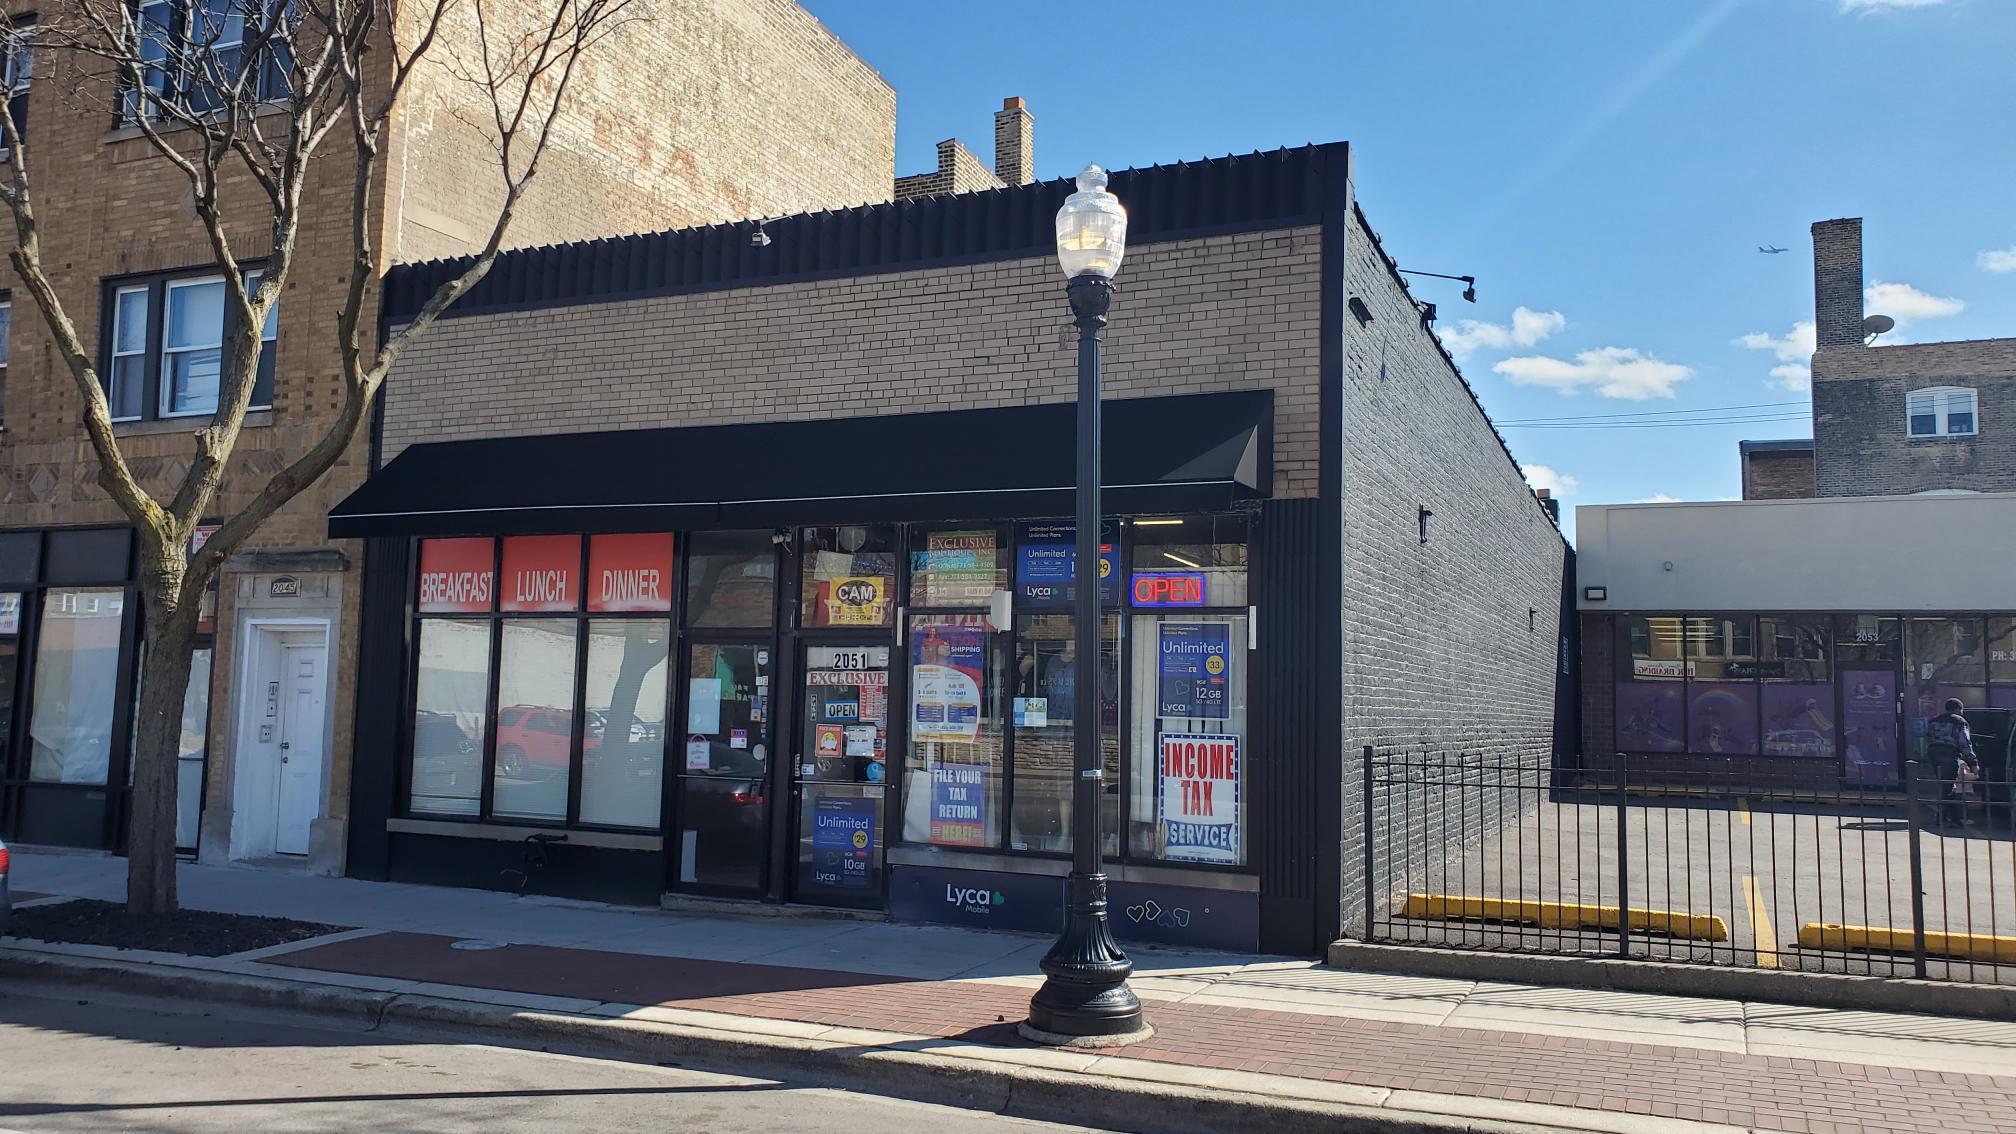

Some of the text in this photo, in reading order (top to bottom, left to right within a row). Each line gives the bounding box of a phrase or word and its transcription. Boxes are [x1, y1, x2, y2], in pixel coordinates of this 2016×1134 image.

[930, 536, 994, 550] EXCLUSIVE
[1028, 549, 1066, 558] Unlimited
[273, 583, 296, 594] 2045
[420, 572, 493, 602] BREAKFAST
[516, 570, 567, 602] LUNCH
[602, 569, 660, 602] DINNER
[1027, 586, 1050, 597] Lyca
[1134, 577, 1202, 602] OPEN
[838, 585, 873, 600] CAM
[1856, 633, 1878, 642] 2053
[1163, 641, 1224, 654] Unlimited
[834, 654, 866, 668] 2051
[1992, 650, 2007, 661] PH:
[810, 673, 885, 684] EXCLUSIVE
[1196, 688, 1206, 698] 12
[829, 705, 855, 717] OPEN
[1163, 702, 1185, 712] Lyca
[1165, 743, 1234, 780] INCOME
[934, 770, 981, 784] FILE YOUR
[948, 787, 967, 800] TAX
[1181, 780, 1213, 816] TAX
[939, 805, 977, 819] RETURN
[818, 816, 869, 829] Unlimited
[1170, 824, 1227, 847] SERVICE
[816, 871, 835, 881] Lyca
[947, 884, 990, 906] Lyca
[965, 905, 989, 913] Mobile
